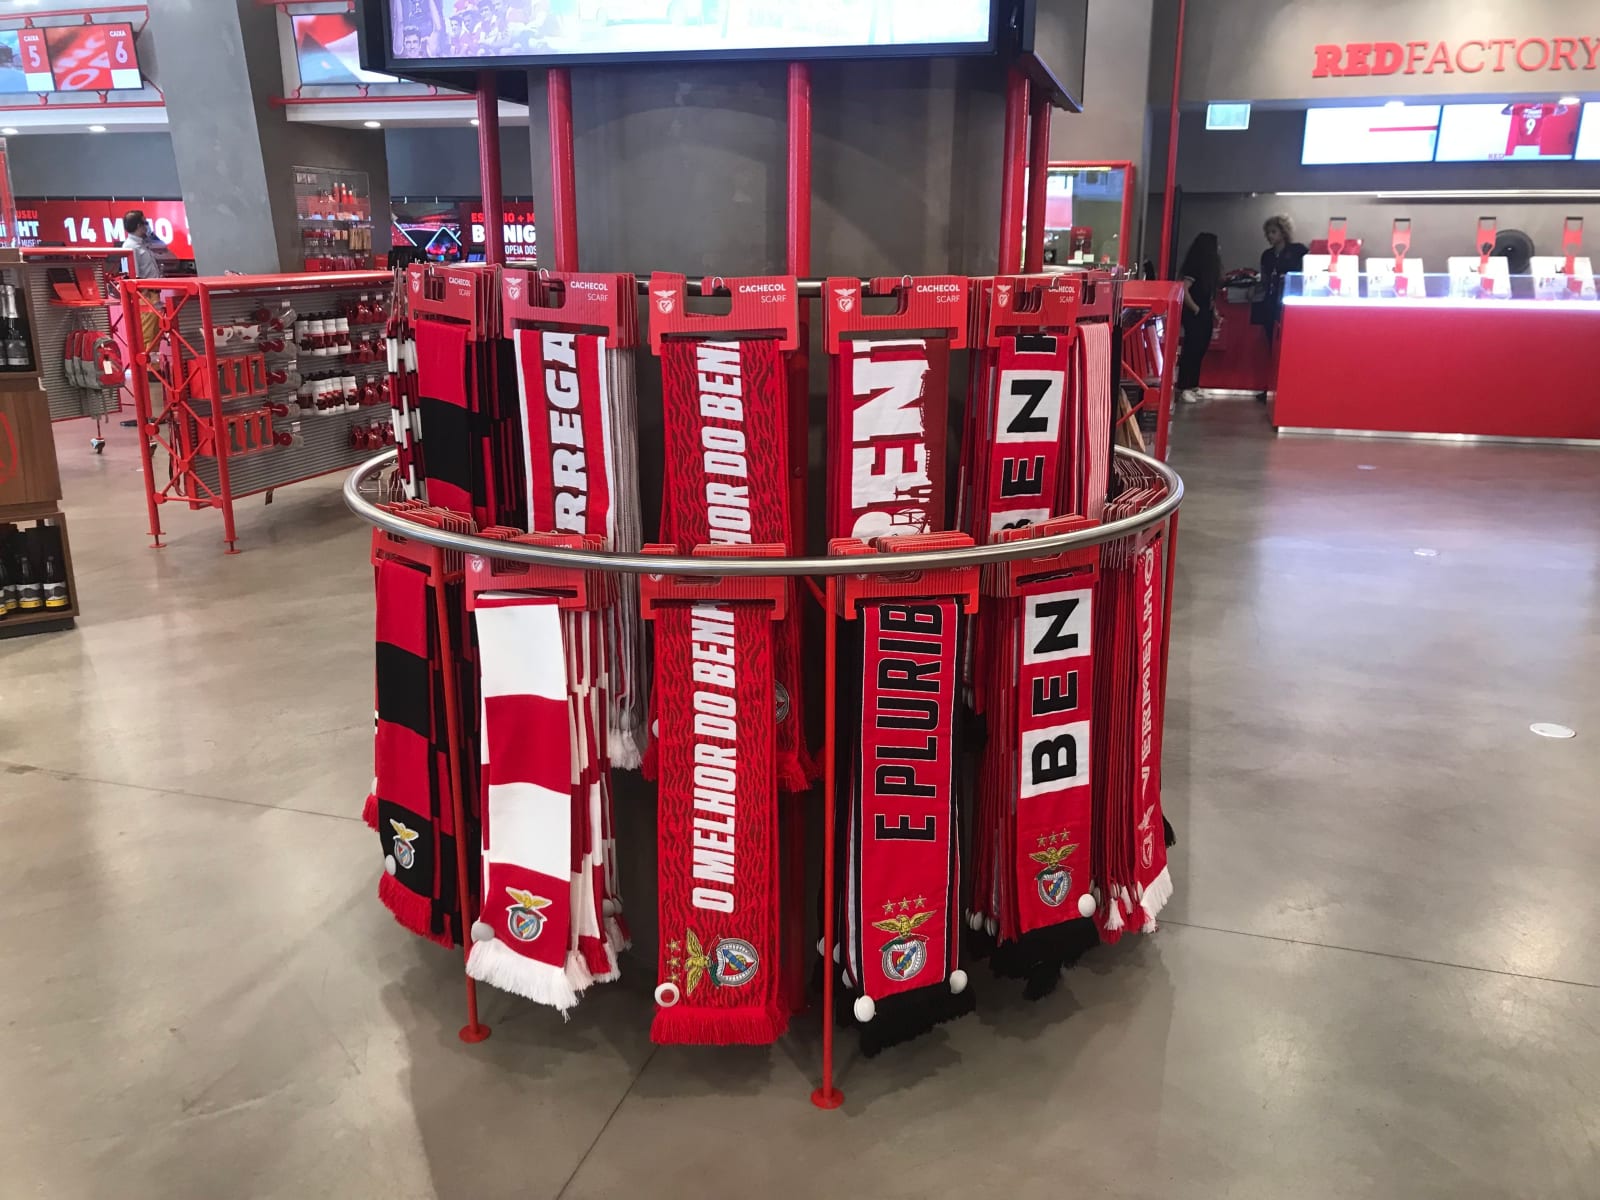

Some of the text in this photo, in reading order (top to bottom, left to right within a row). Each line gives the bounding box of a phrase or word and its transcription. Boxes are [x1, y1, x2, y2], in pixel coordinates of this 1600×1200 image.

[28, 45, 40, 68] 5
[115, 41, 128, 63] 6
[1525, 118, 1536, 135] 9
[63, 217, 97, 243] 14
[103, 217, 174, 245] MO
[570, 280, 609, 291] CACHECOL
[739, 282, 787, 294] CACHECOL
[916, 283, 961, 294] CACHECOL
[587, 292, 608, 302] SCARF
[760, 294, 787, 305] SCARF
[936, 294, 961, 304] SCARF
[701, 425, 748, 479] DO
[1031, 598, 1080, 786] BEN
[693, 690, 737, 741] DO
[874, 603, 943, 843] E PLURIB
[692, 743, 737, 885] MELHOR
[692, 887, 735, 914] O
